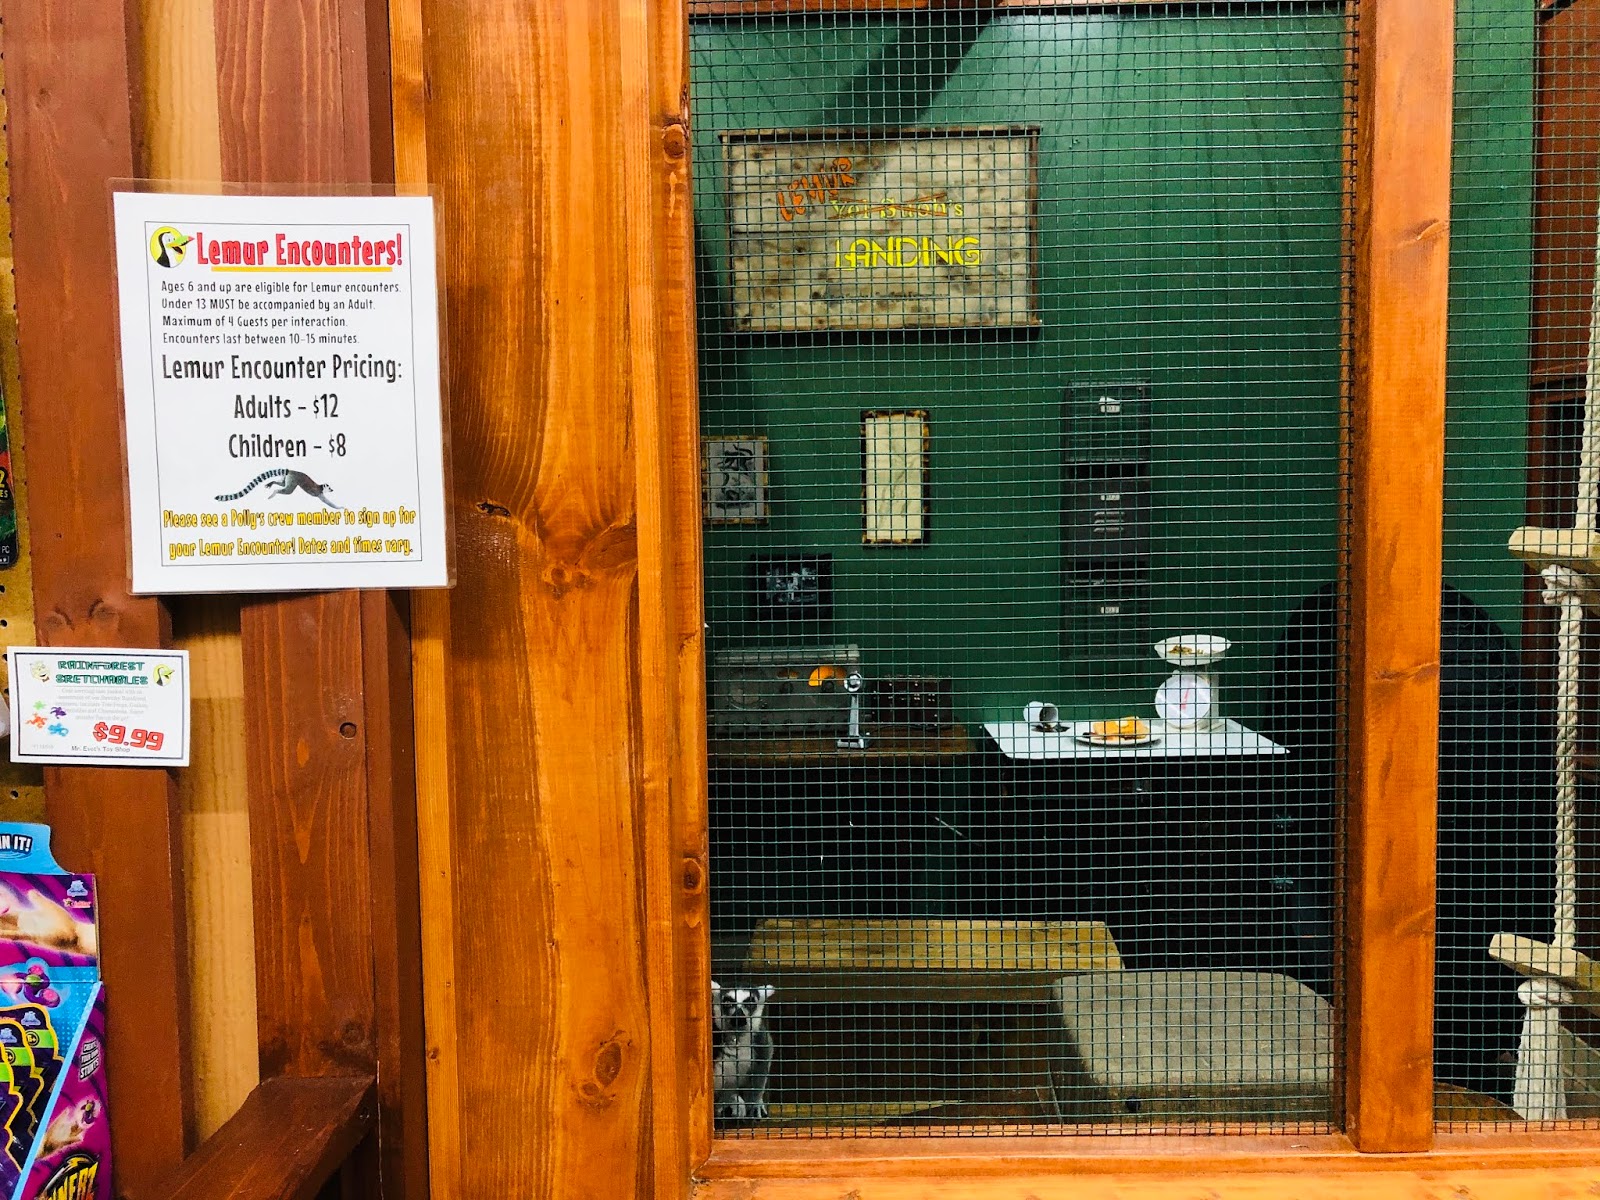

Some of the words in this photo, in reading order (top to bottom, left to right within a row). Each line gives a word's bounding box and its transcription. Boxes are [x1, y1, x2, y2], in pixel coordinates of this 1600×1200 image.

[776, 157, 855, 221] LEMUR
[196, 232, 269, 265] Lemur
[275, 233, 403, 266] Encounters!
[835, 236, 981, 271] LANDING
[161, 281, 185, 294] Ages
[187, 281, 194, 291] 6
[197, 282, 216, 292] and
[219, 284, 232, 294] up
[234, 283, 252, 293] are
[255, 282, 290, 294] eligible
[292, 282, 307, 293] for
[310, 282, 342, 293] Lemur
[344, 283, 401, 293] encounters.
[161, 298, 193, 309] Under
[196, 299, 207, 309] 13
[209, 299, 236, 309] MUST
[238, 299, 250, 310] be
[252, 299, 315, 311] accompanied
[318, 299, 330, 311] by
[333, 300, 346, 310] an
[348, 299, 375, 310] Adult.
[162, 315, 212, 327] Maximum
[215, 315, 226, 326] of
[228, 316, 234, 326] 4
[237, 316, 269, 327] Guests
[271, 318, 288, 329] per
[291, 316, 348, 327] interaction.
[162, 333, 220, 344] Encounters
[223, 333, 242, 344] last
[244, 333, 286, 344] between
[289, 334, 316, 344] 10-15
[318, 334, 359, 344] minutes.
[162, 354, 225, 379] Lemur
[231, 355, 326, 380] Encounter
[333, 354, 403, 383] Pricing:
[234, 395, 292, 419] Adults
[313, 394, 339, 419] $12
[228, 434, 307, 458] Children
[328, 433, 346, 457] $8
[164, 511, 198, 527] Please
[201, 513, 218, 527] see
[221, 513, 228, 526] a
[231, 510, 265, 530] Polly's
[267, 513, 294, 526] crew
[297, 509, 340, 526] member
[344, 509, 355, 524] to
[358, 509, 380, 527] sign
[383, 511, 396, 527] up
[399, 507, 416, 524] for
[169, 541, 195, 560] your
[199, 540, 234, 557] Lemur
[237, 538, 296, 556] Encounter!
[299, 537, 327, 554] Dates
[331, 537, 350, 553] and
[353, 537, 382, 553] times
[385, 539, 413, 556] vary.
[58, 660, 146, 671] RAINFOREST
[92, 722, 164, 751] $9.99
[14, 835, 31, 852] IT!
